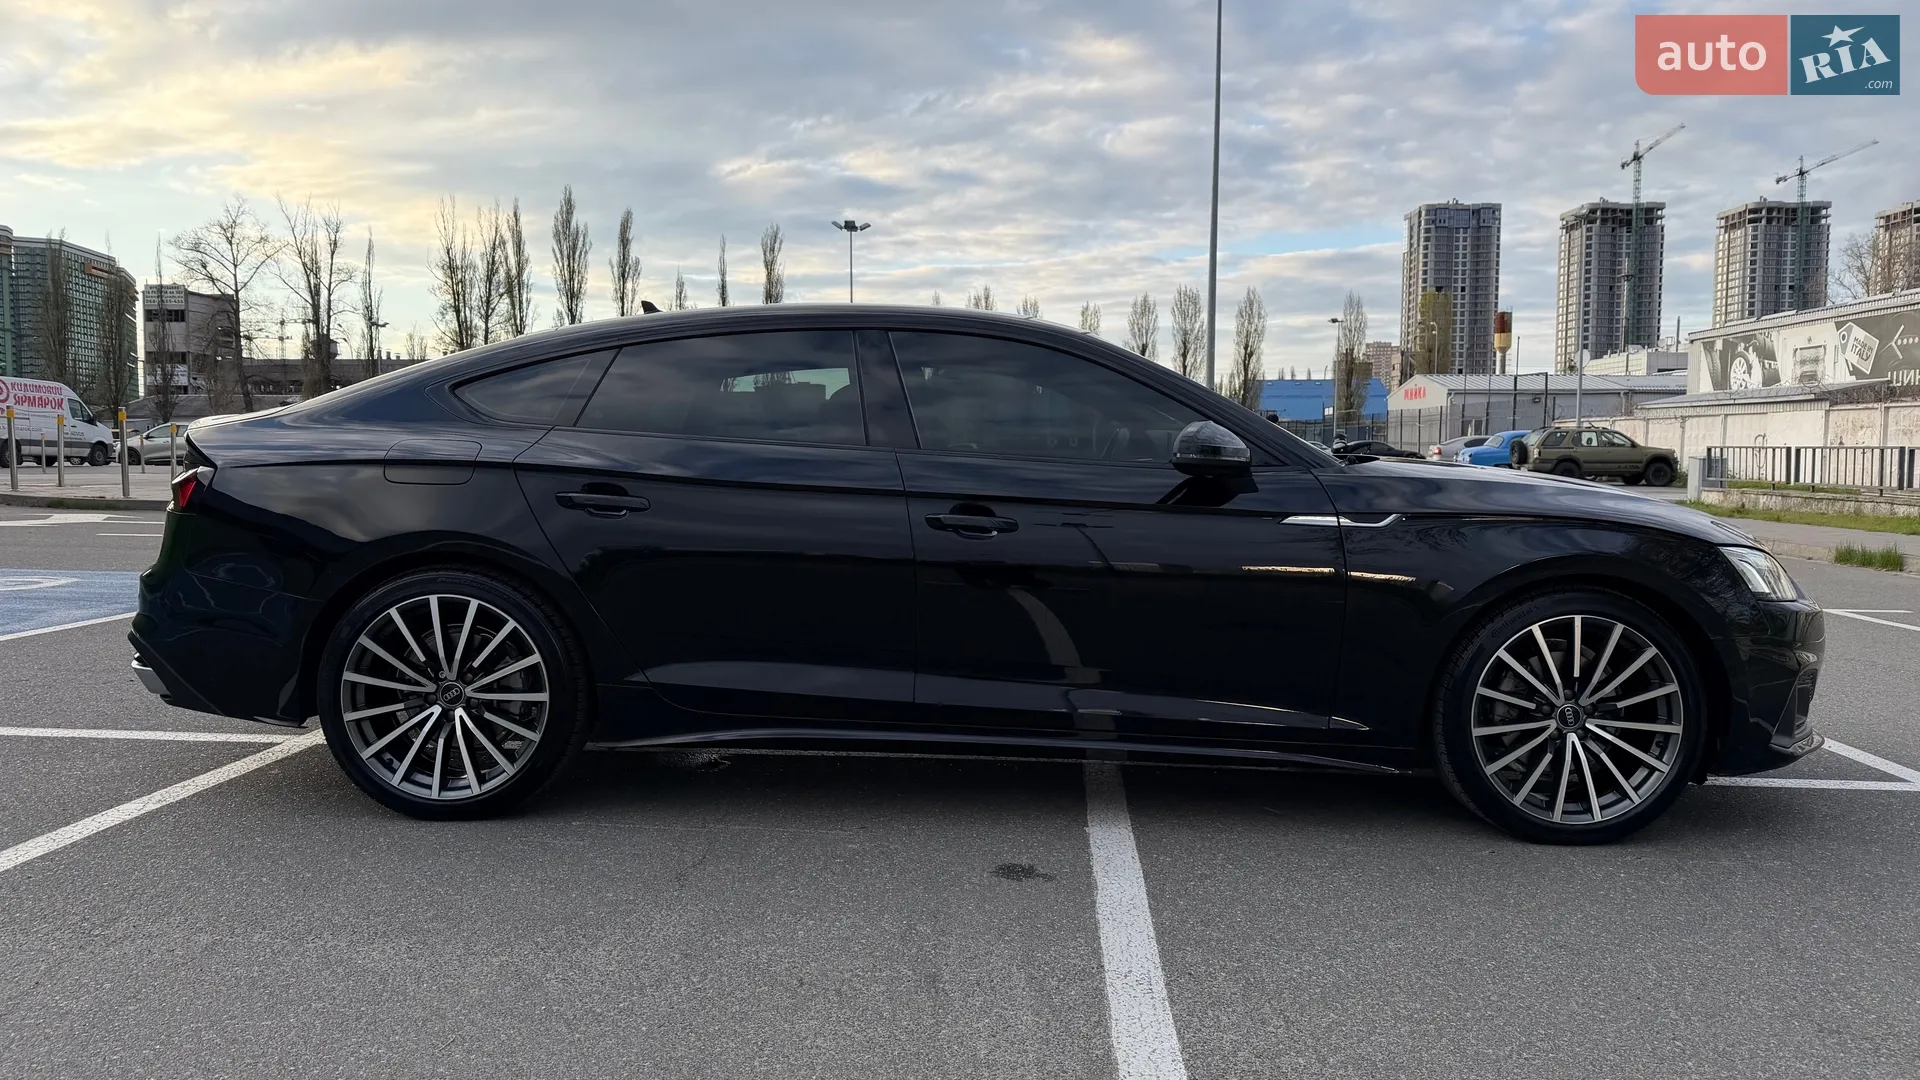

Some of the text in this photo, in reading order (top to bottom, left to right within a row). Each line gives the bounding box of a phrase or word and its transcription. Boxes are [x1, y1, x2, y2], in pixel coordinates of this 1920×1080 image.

[1850, 343, 1872, 362] ITALY
[1853, 336, 1868, 351] MADE
[13, 393, 65, 411] ЯРМАРОК
